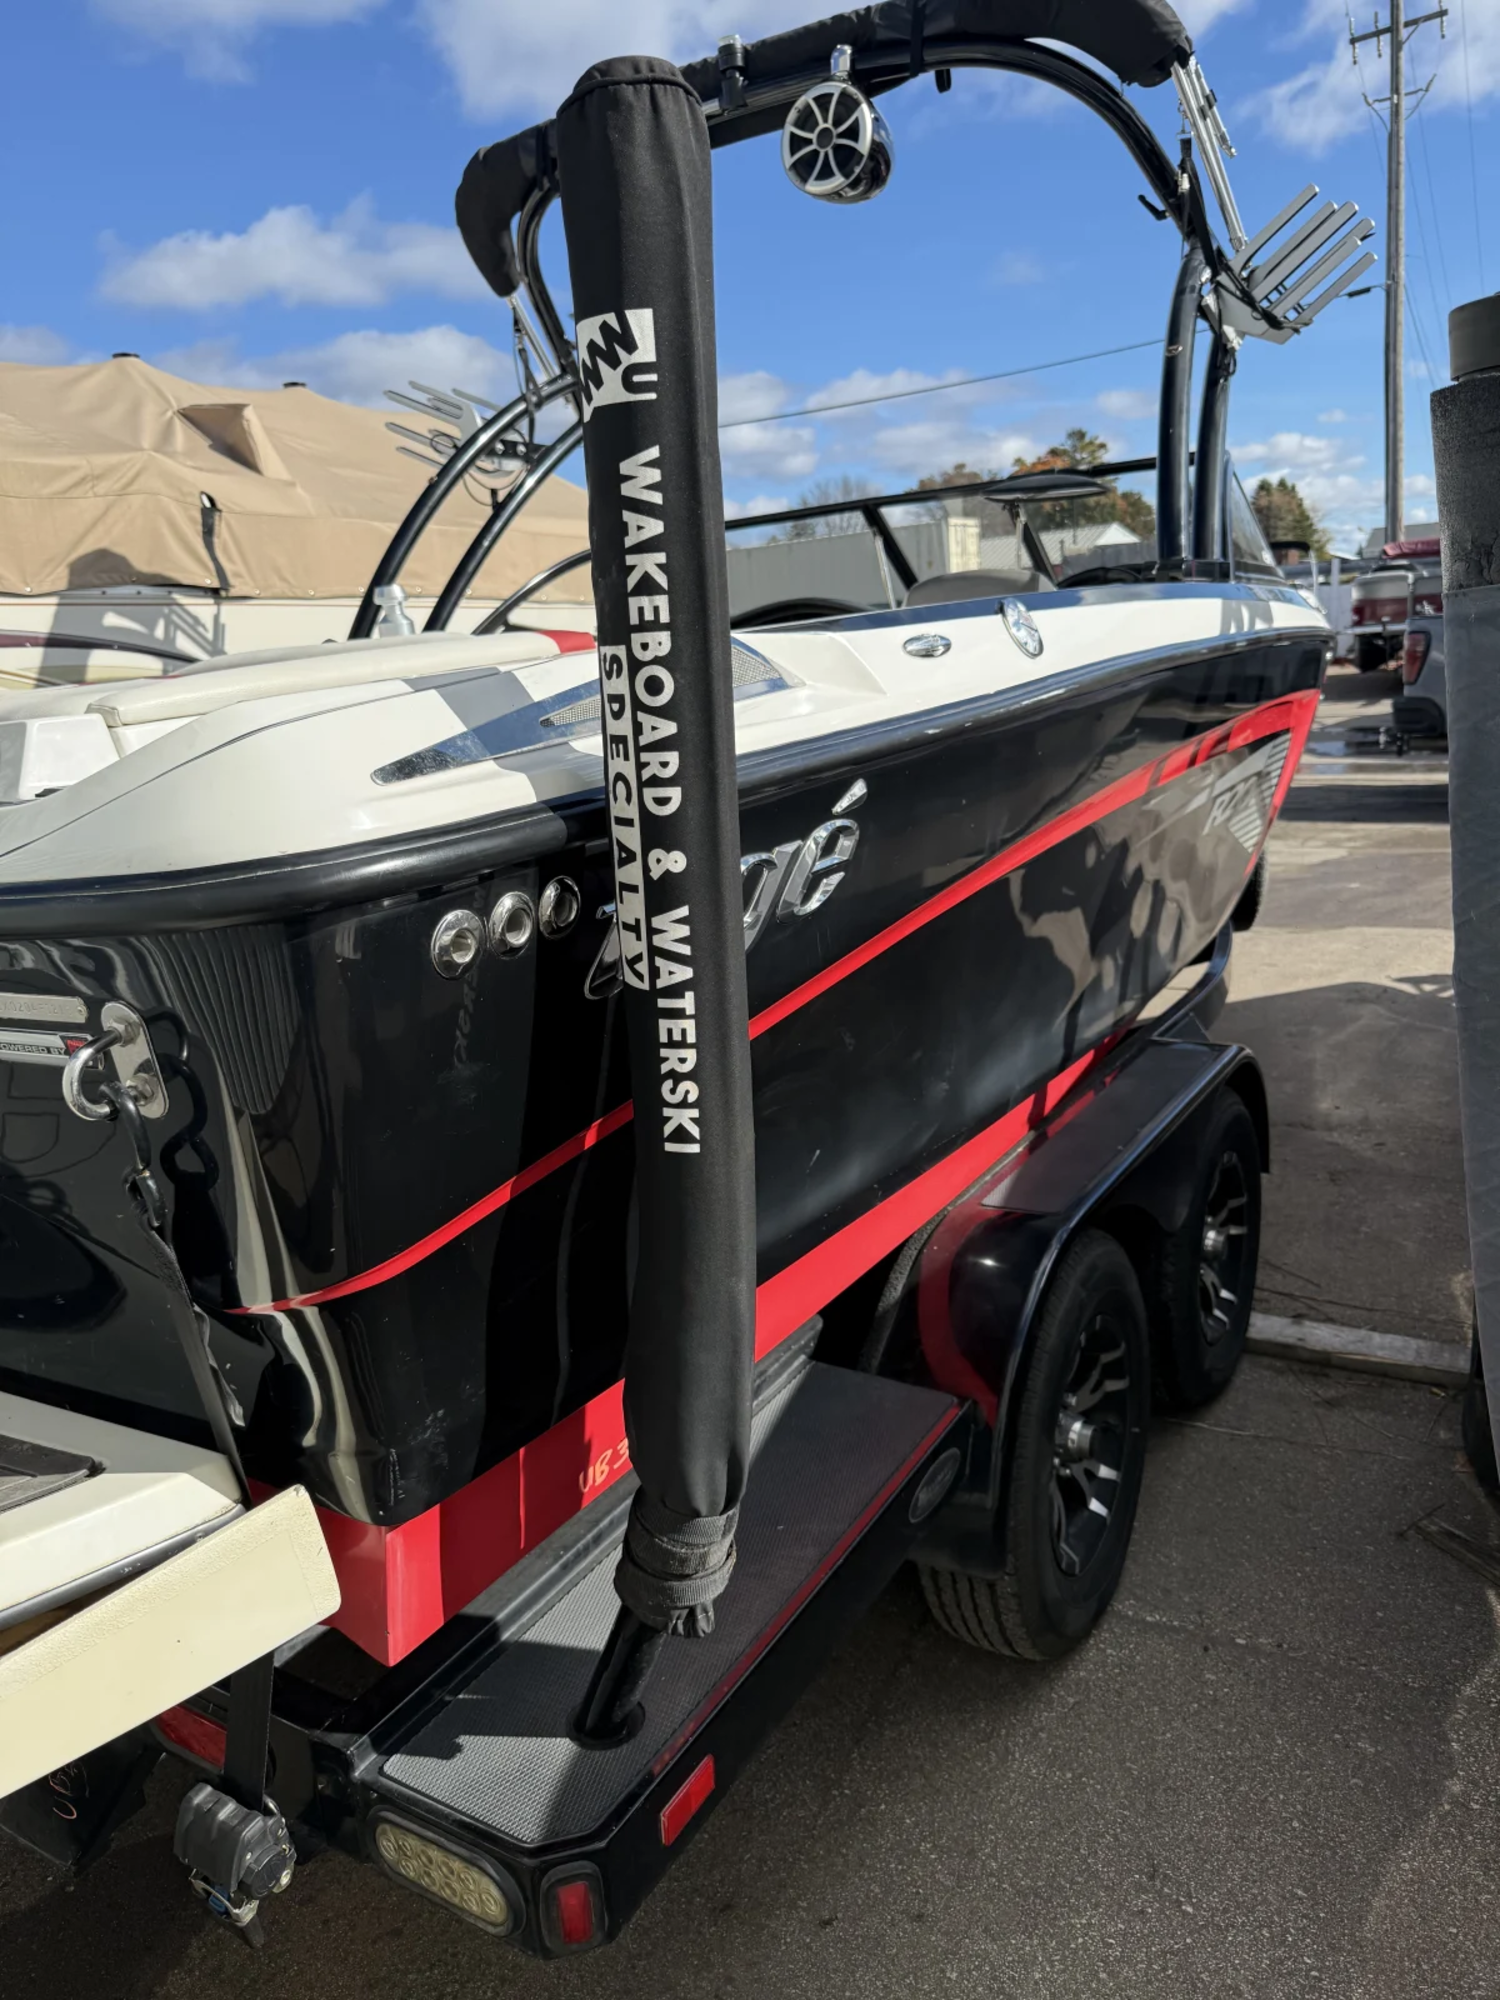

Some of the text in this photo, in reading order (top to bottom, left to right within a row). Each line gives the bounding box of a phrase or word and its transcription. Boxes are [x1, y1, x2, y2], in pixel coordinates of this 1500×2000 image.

[602, 652, 647, 985] SPECIALTY
[619, 444, 701, 1154] WAKEBOARD & WATERSKI
[50, 1047, 66, 1055] BY
